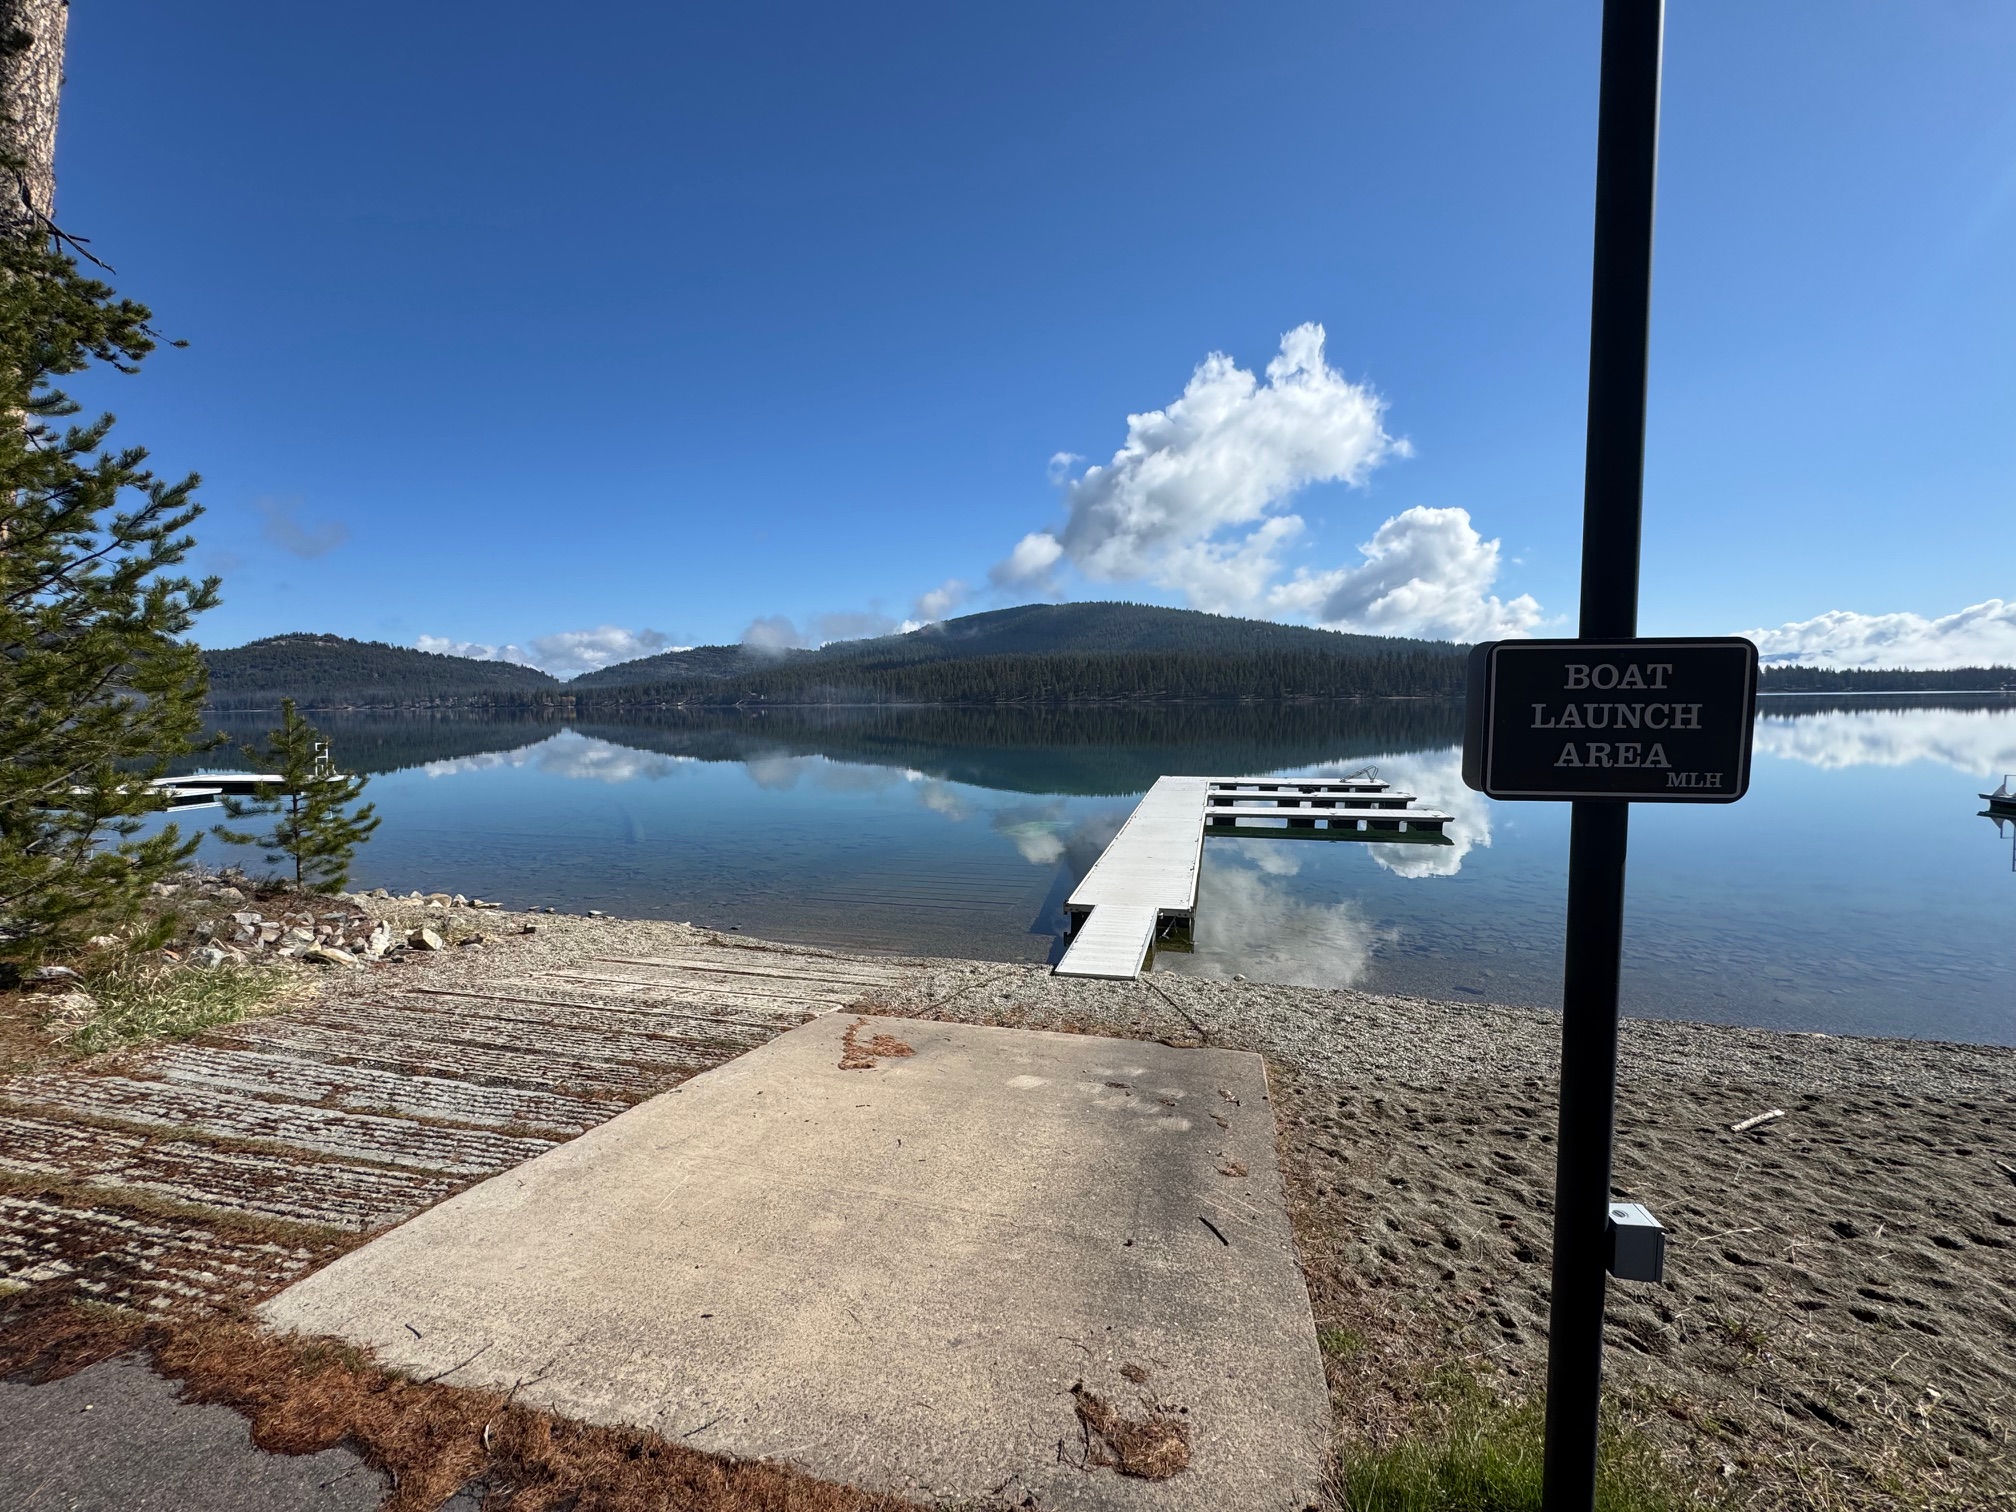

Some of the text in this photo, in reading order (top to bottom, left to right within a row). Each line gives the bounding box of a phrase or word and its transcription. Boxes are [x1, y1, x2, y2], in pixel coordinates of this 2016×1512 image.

[1563, 664, 1673, 690] BOAT
[1530, 703, 1703, 729] LAUNCH
[1553, 742, 1672, 768] AREA
[1666, 772, 1723, 788] MLH
